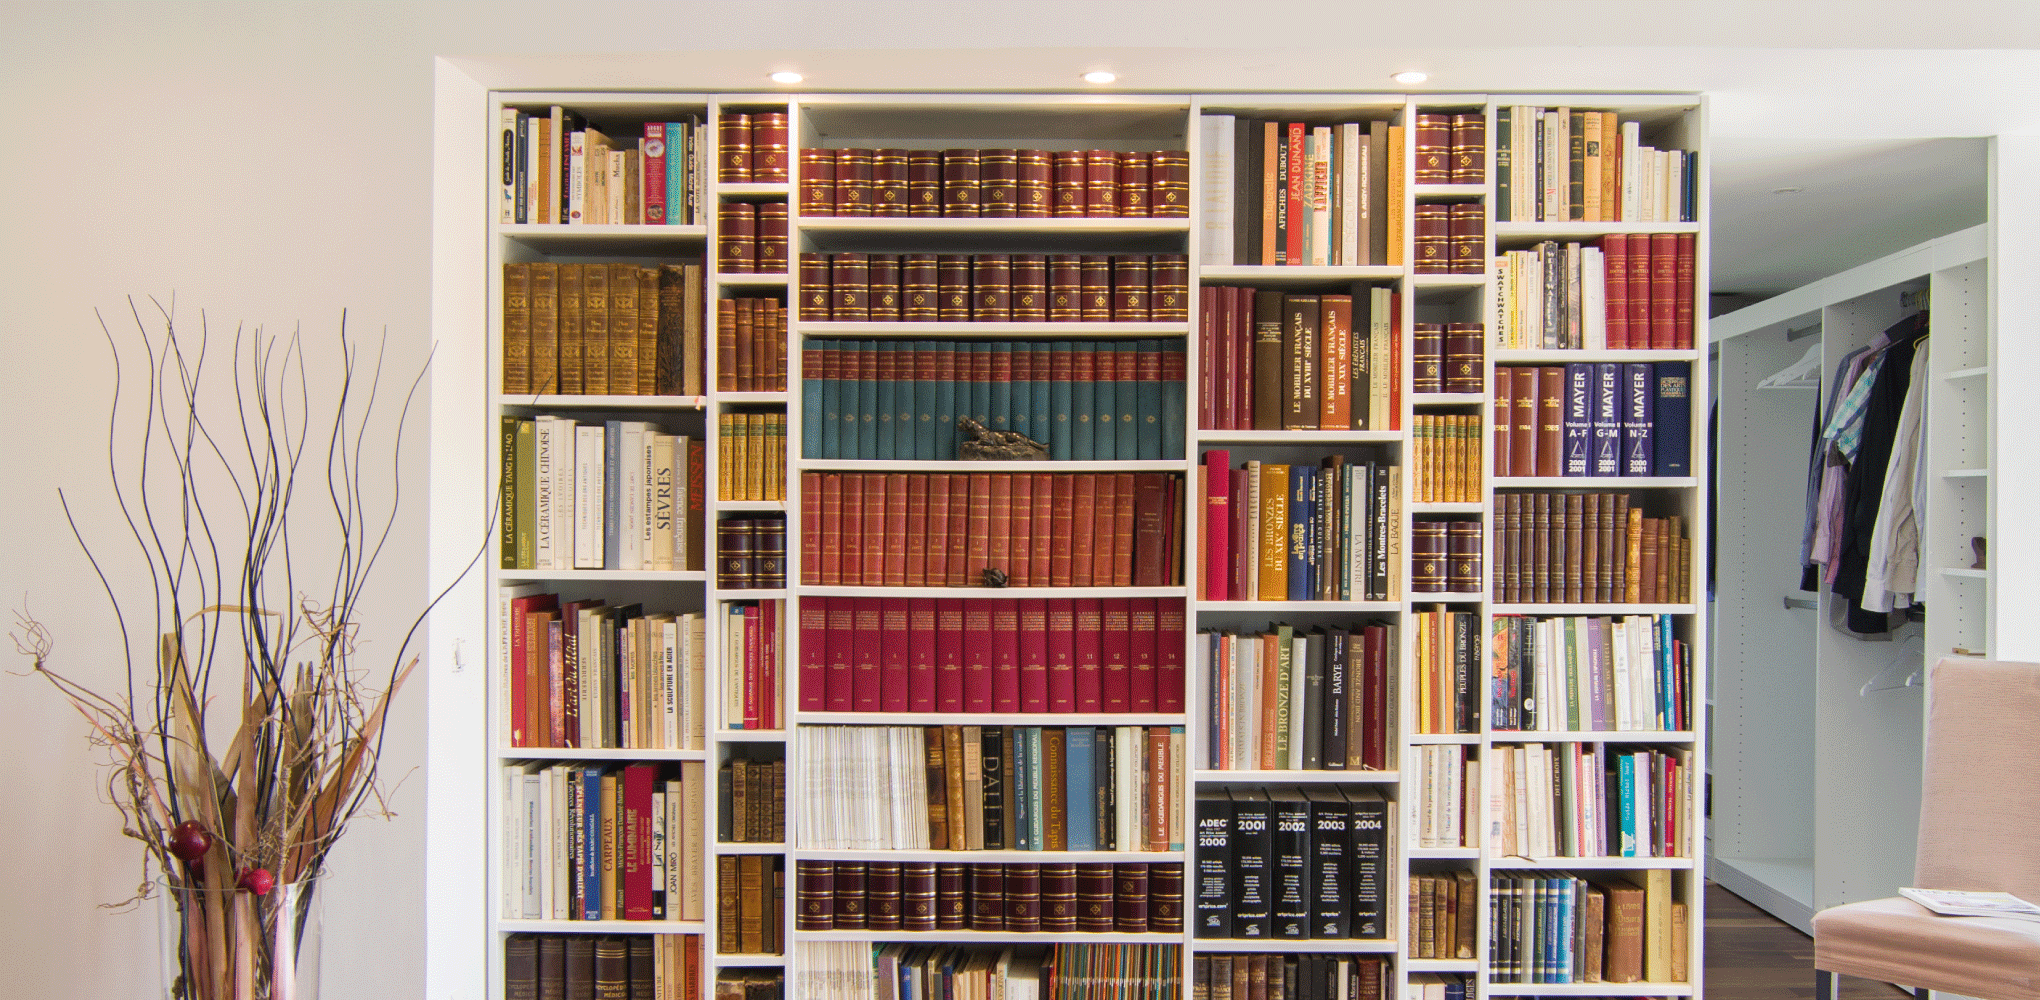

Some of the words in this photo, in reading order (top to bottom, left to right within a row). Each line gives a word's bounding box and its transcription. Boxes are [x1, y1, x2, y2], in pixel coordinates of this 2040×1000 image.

[1278, 144, 1287, 180] DUBOUT
[1290, 127, 1302, 173] DUNAND
[612, 154, 620, 178] Mucha
[1290, 175, 1302, 201] JEAN
[1303, 154, 1314, 208] ZADKINE
[1278, 188, 1287, 230] AFFICHES
[1294, 312, 1304, 354] FRANÇAIS
[1303, 327, 1312, 358] SIÈCLE
[1328, 310, 1337, 354] FRANÇAIS
[1372, 322, 1380, 350] FRANÇAIS
[1382, 322, 1390, 350] FRANÇAIS
[1337, 329, 1346, 360] SIÈCLE
[1293, 356, 1302, 400] MOBILIER
[1327, 357, 1335, 400] MOBILIER
[1338, 382, 1346, 395] DU
[1304, 385, 1312, 398] DU
[1574, 372, 1585, 417] MAYER
[1602, 372, 1614, 417] MAYER
[1634, 372, 1645, 417] MAYER
[1293, 401, 1302, 413] LE
[1327, 402, 1335, 414] LE
[1569, 429, 1587, 438] A-F
[1596, 429, 1618, 438] G-M
[1630, 429, 1648, 438] N-Z
[540, 428, 550, 474] CHINOISE
[644, 446, 653, 486] japonaises
[690, 445, 704, 511] MEISSEN
[1318, 478, 1323, 487] LA
[504, 484, 514, 532] CÉRAMIQUE
[538, 476, 551, 534] CÉRAMIQUE
[645, 488, 653, 526] estampes
[655, 467, 671, 530] SÈVRES
[1265, 498, 1274, 544] BRONZES
[1274, 494, 1284, 530] SIÈCLE
[1318, 514, 1323, 523] DE
[1377, 485, 1386, 559] Montres-Bracelets
[1390, 508, 1398, 538] BAGUE
[504, 533, 514, 544] LA
[540, 536, 550, 549] LA
[644, 528, 652, 541] Les
[1354, 534, 1362, 544] LA
[1265, 548, 1274, 567] LES
[1390, 543, 1398, 555] LA
[1276, 556, 1284, 571] DU
[1354, 549, 1362, 584] MONTRE
[1377, 560, 1386, 576] Les
[514, 638, 521, 647] LA
[666, 664, 673, 672] EN
[1278, 646, 1290, 680] D'ART
[1460, 651, 1466, 662] DU
[1332, 664, 1342, 694] BARYE
[666, 706, 673, 714] LA
[1278, 683, 1288, 732] BRONZE
[1278, 734, 1288, 751] LE
[1050, 736, 1060, 802] Connaissance
[1158, 772, 1164, 782] DU
[576, 785, 584, 828] SPLENDEUR
[1033, 790, 1039, 800] DU
[1050, 806, 1061, 820] du
[1199, 819, 1226, 827] ADEC
[1354, 820, 1382, 829] 2004
[626, 808, 637, 860] LUMINAIRE
[1048, 821, 1061, 849] Tapis
[1158, 827, 1164, 836] LE
[1238, 821, 1265, 830] 2001
[1278, 822, 1305, 831] 2002
[1318, 821, 1345, 830] 2003
[603, 817, 613, 871] CARPEAUX
[1034, 836, 1039, 844] LE
[1199, 838, 1226, 846] 2000
[576, 842, 584, 865] TAPIS
[626, 862, 637, 872] LE
[669, 874, 678, 895] JOAN
